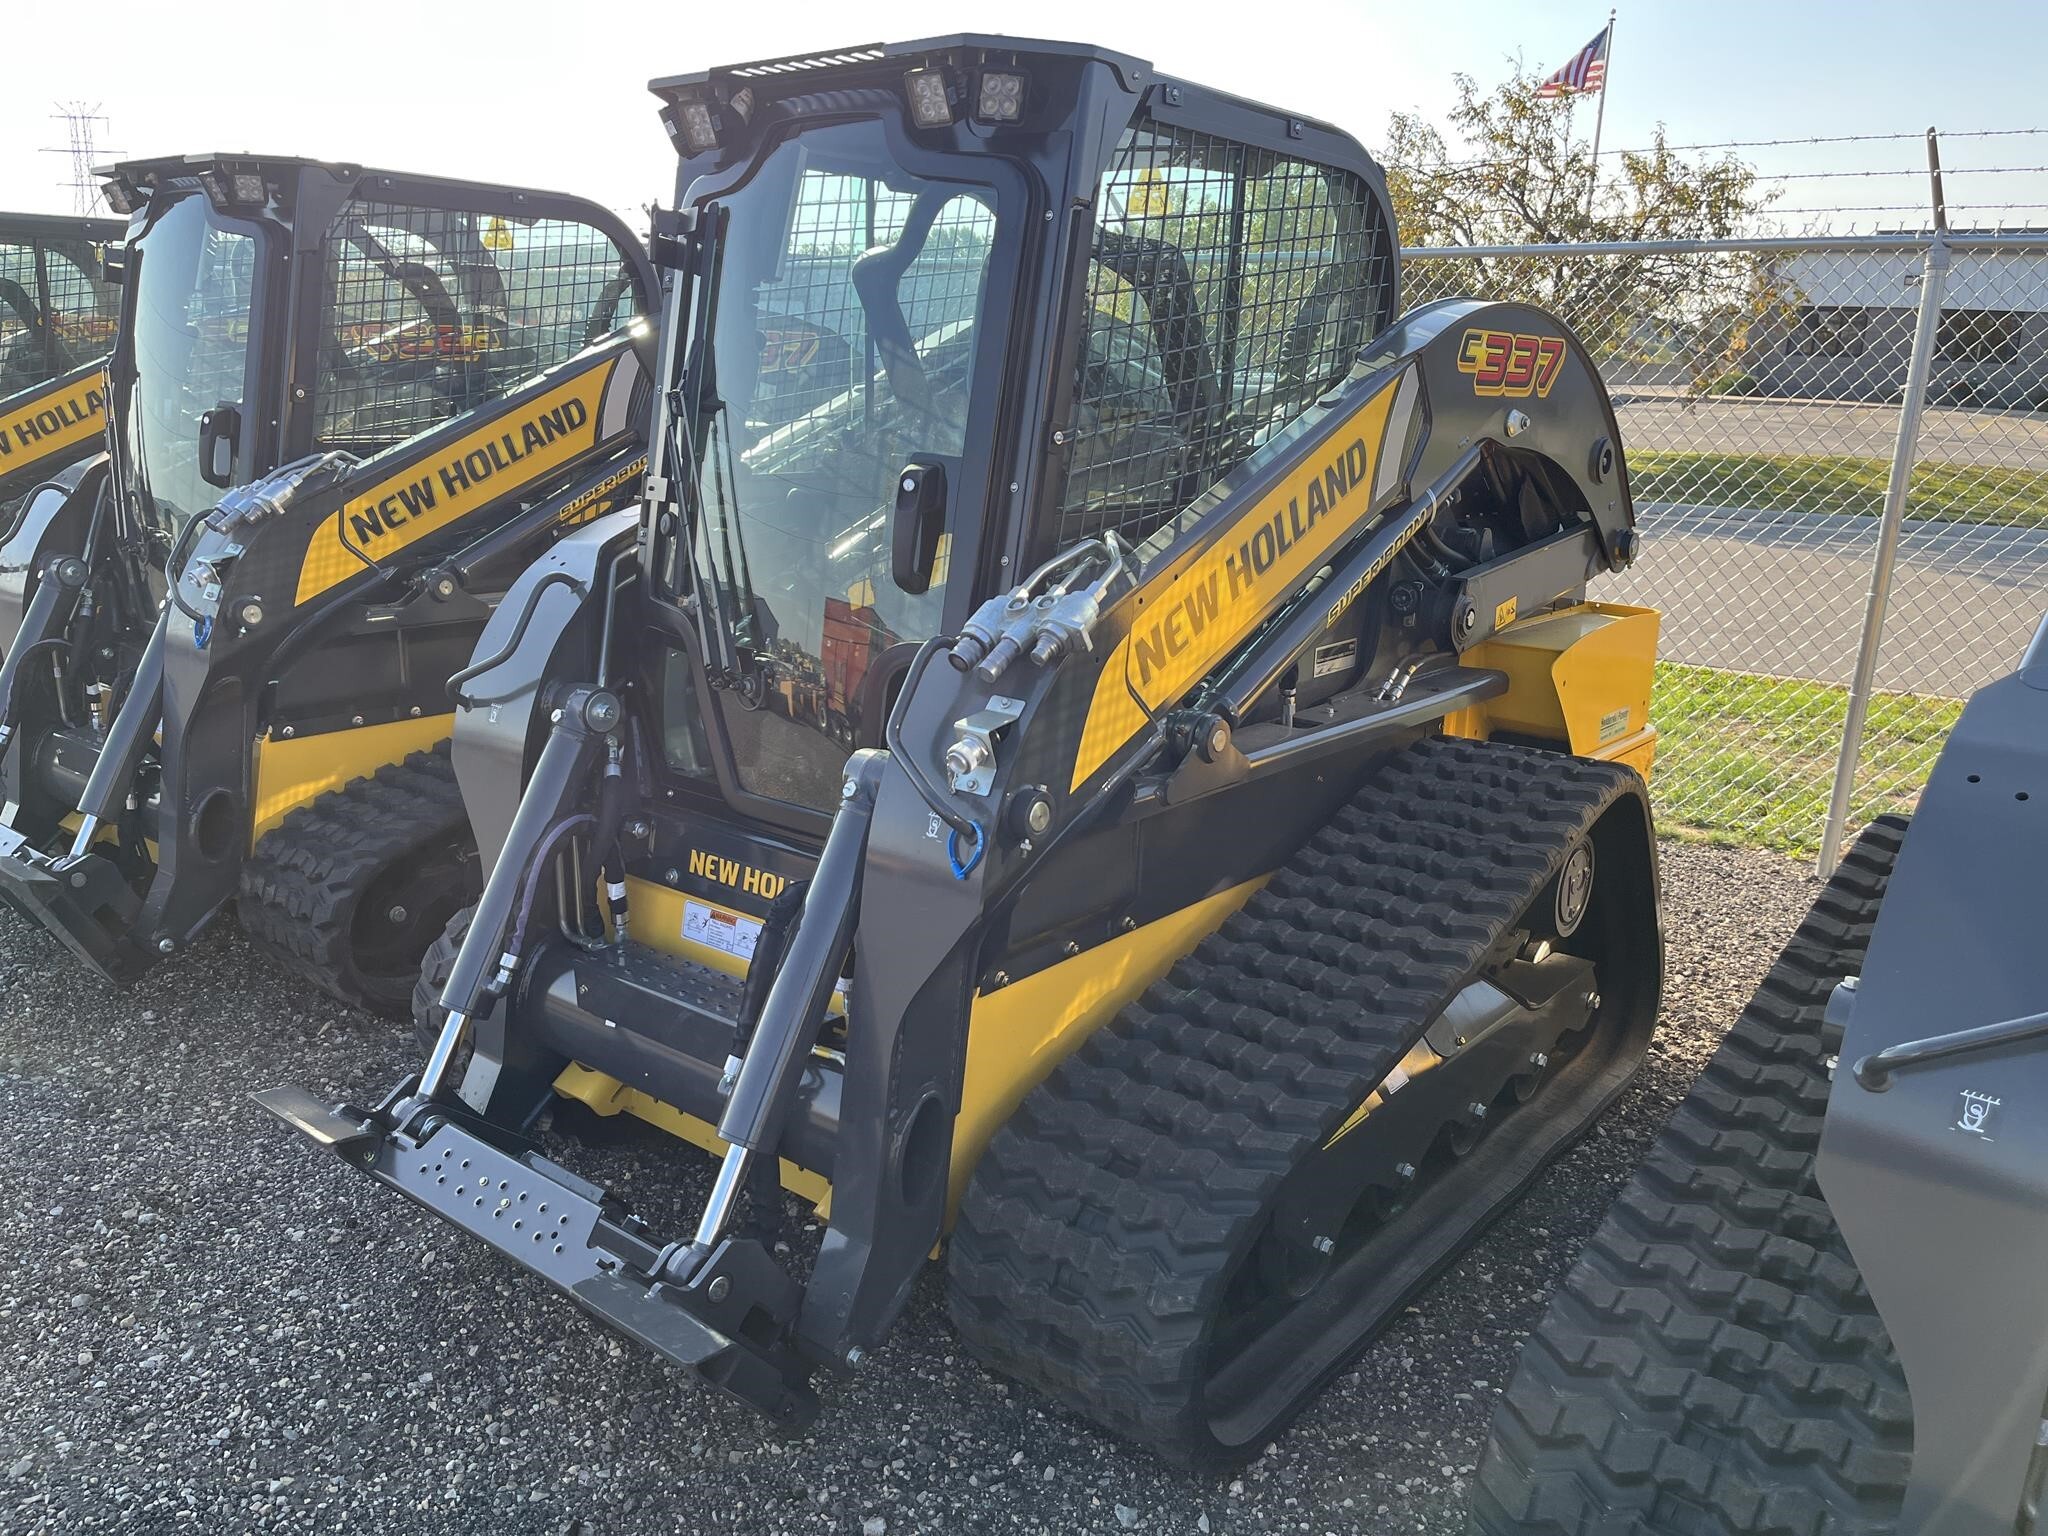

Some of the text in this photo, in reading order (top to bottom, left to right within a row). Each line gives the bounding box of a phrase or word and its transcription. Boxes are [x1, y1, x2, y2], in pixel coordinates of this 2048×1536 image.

[1457, 328, 1566, 398] C337
[13, 386, 108, 447] HOLLA
[350, 397, 588, 546] NEW HOLLAND
[1134, 438, 1368, 688] NEW HOLLAND
[689, 849, 740, 887] NEW
